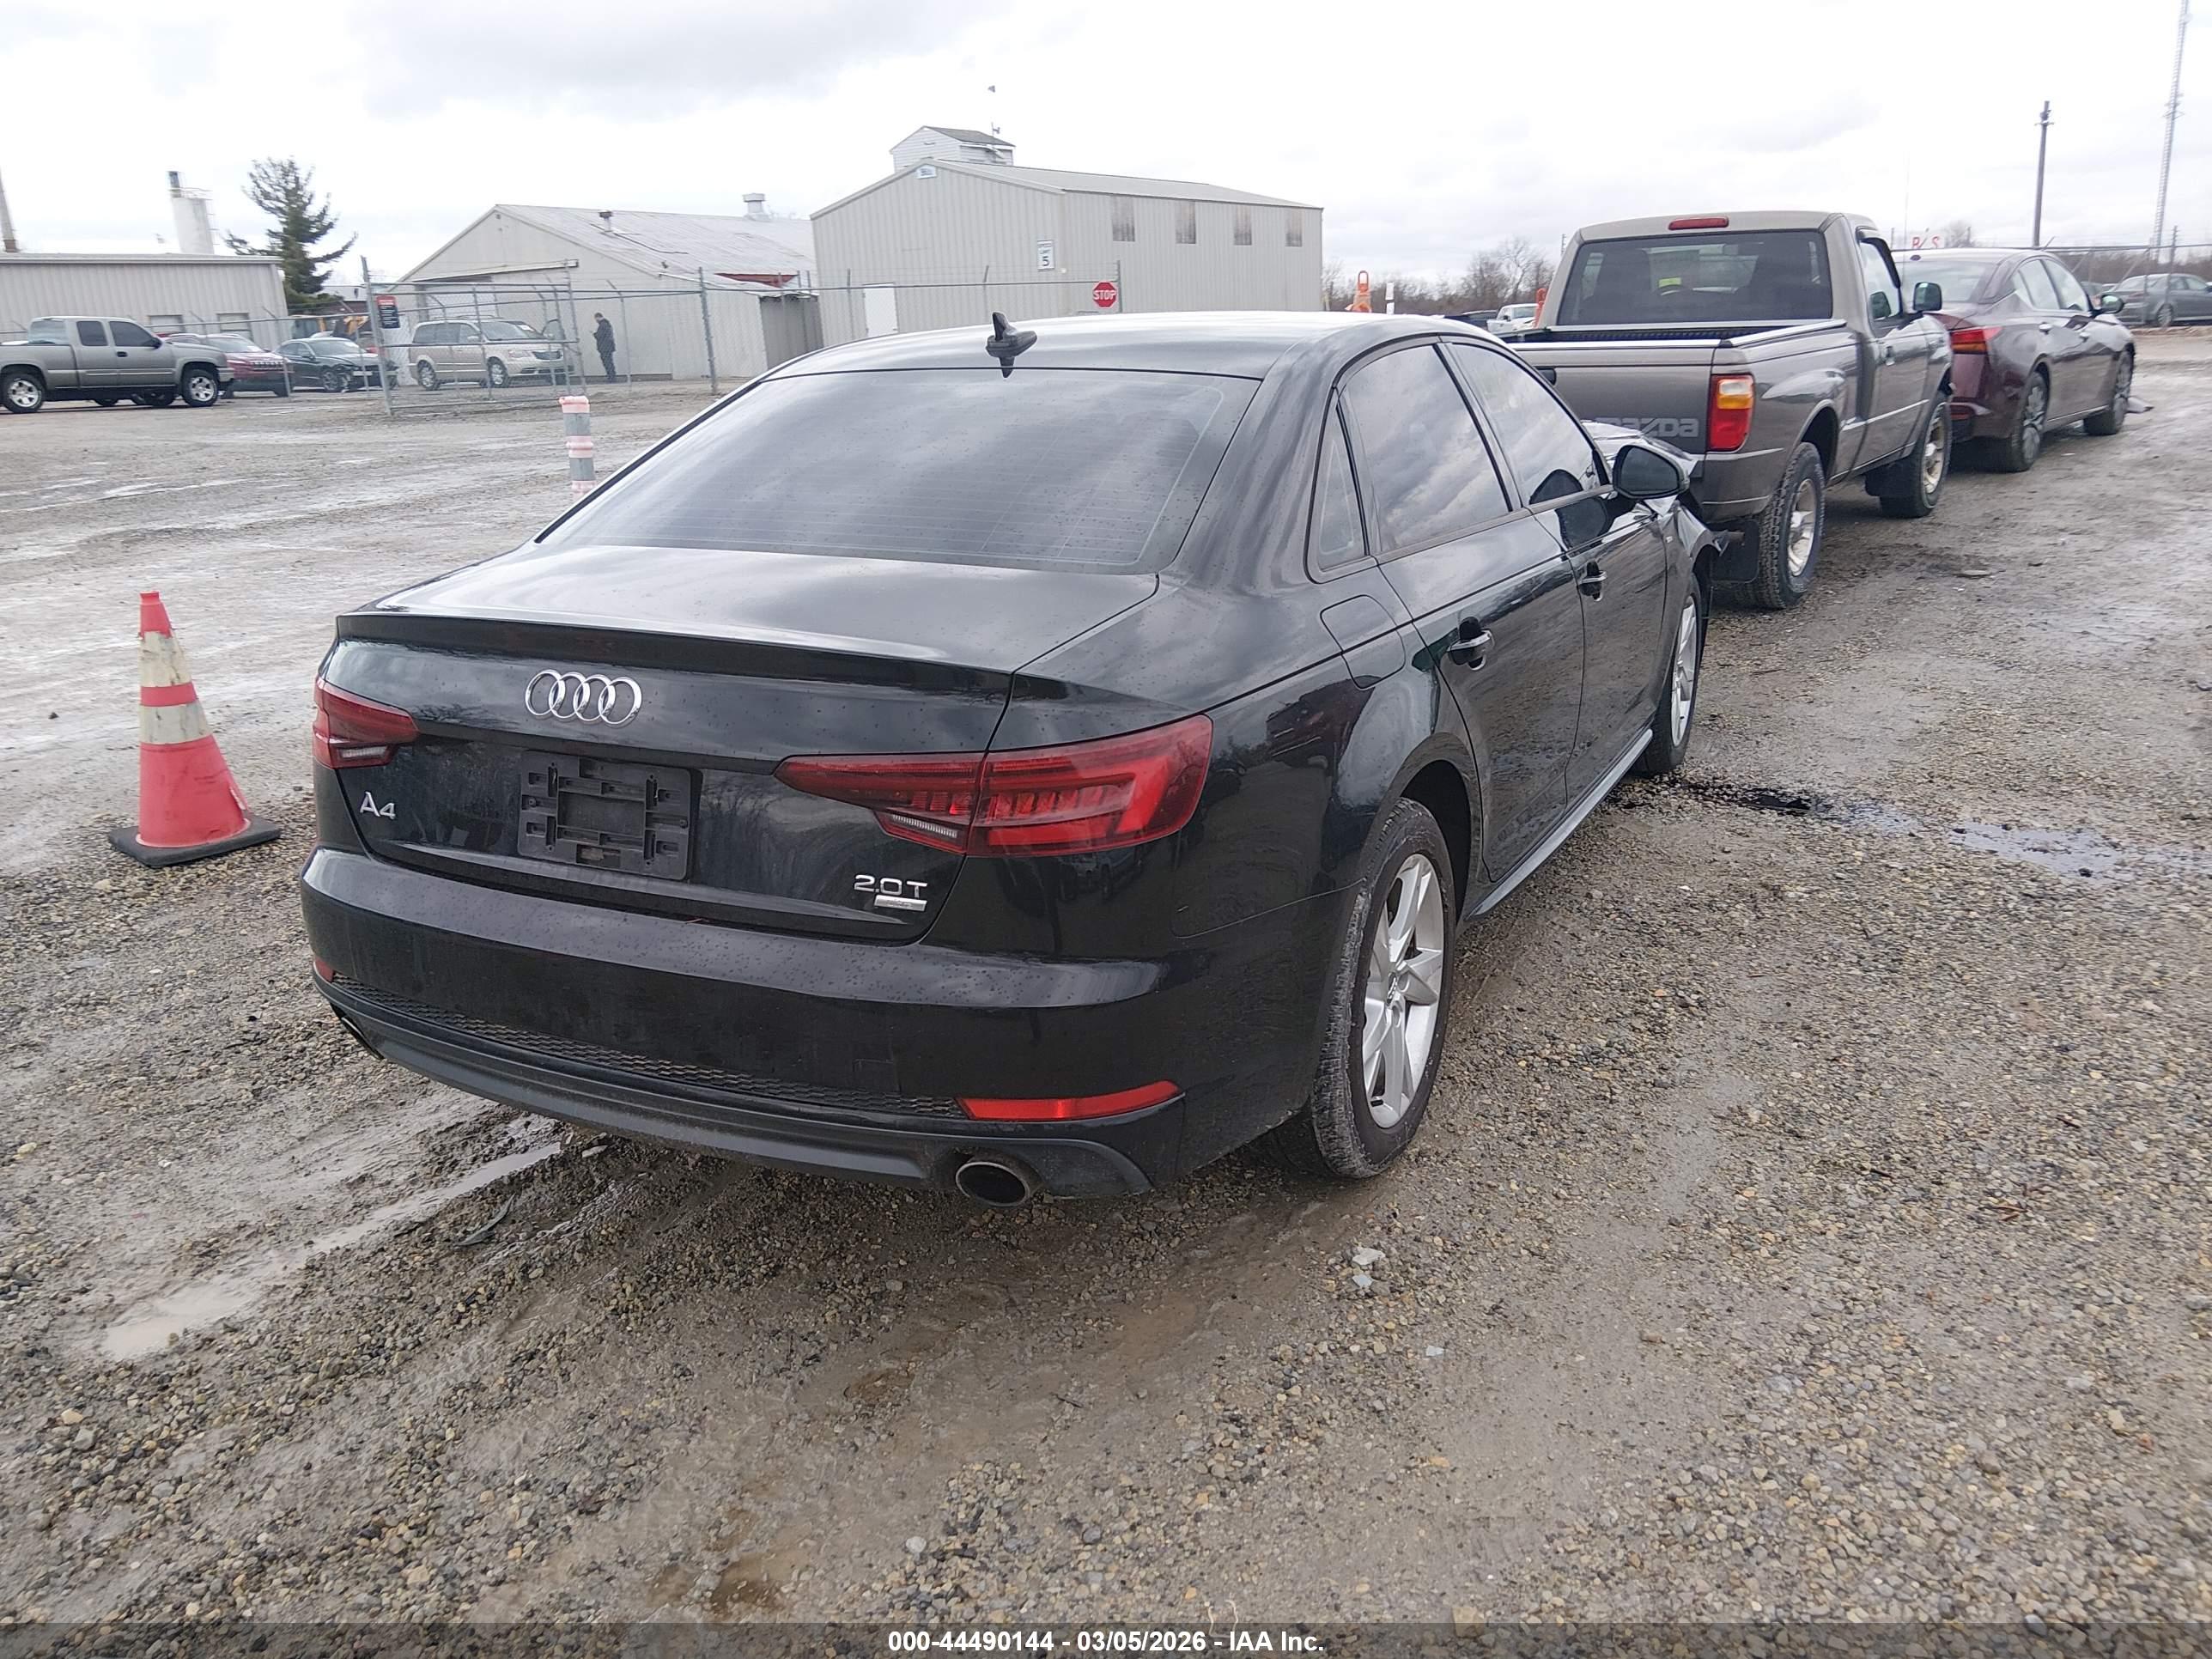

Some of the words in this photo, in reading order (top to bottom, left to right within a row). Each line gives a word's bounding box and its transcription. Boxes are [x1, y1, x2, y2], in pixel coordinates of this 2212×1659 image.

[1042, 255, 1050, 267] 5
[1093, 289, 1116, 301] STOP
[360, 791, 396, 820] A4
[854, 874, 928, 899] 2.0T
